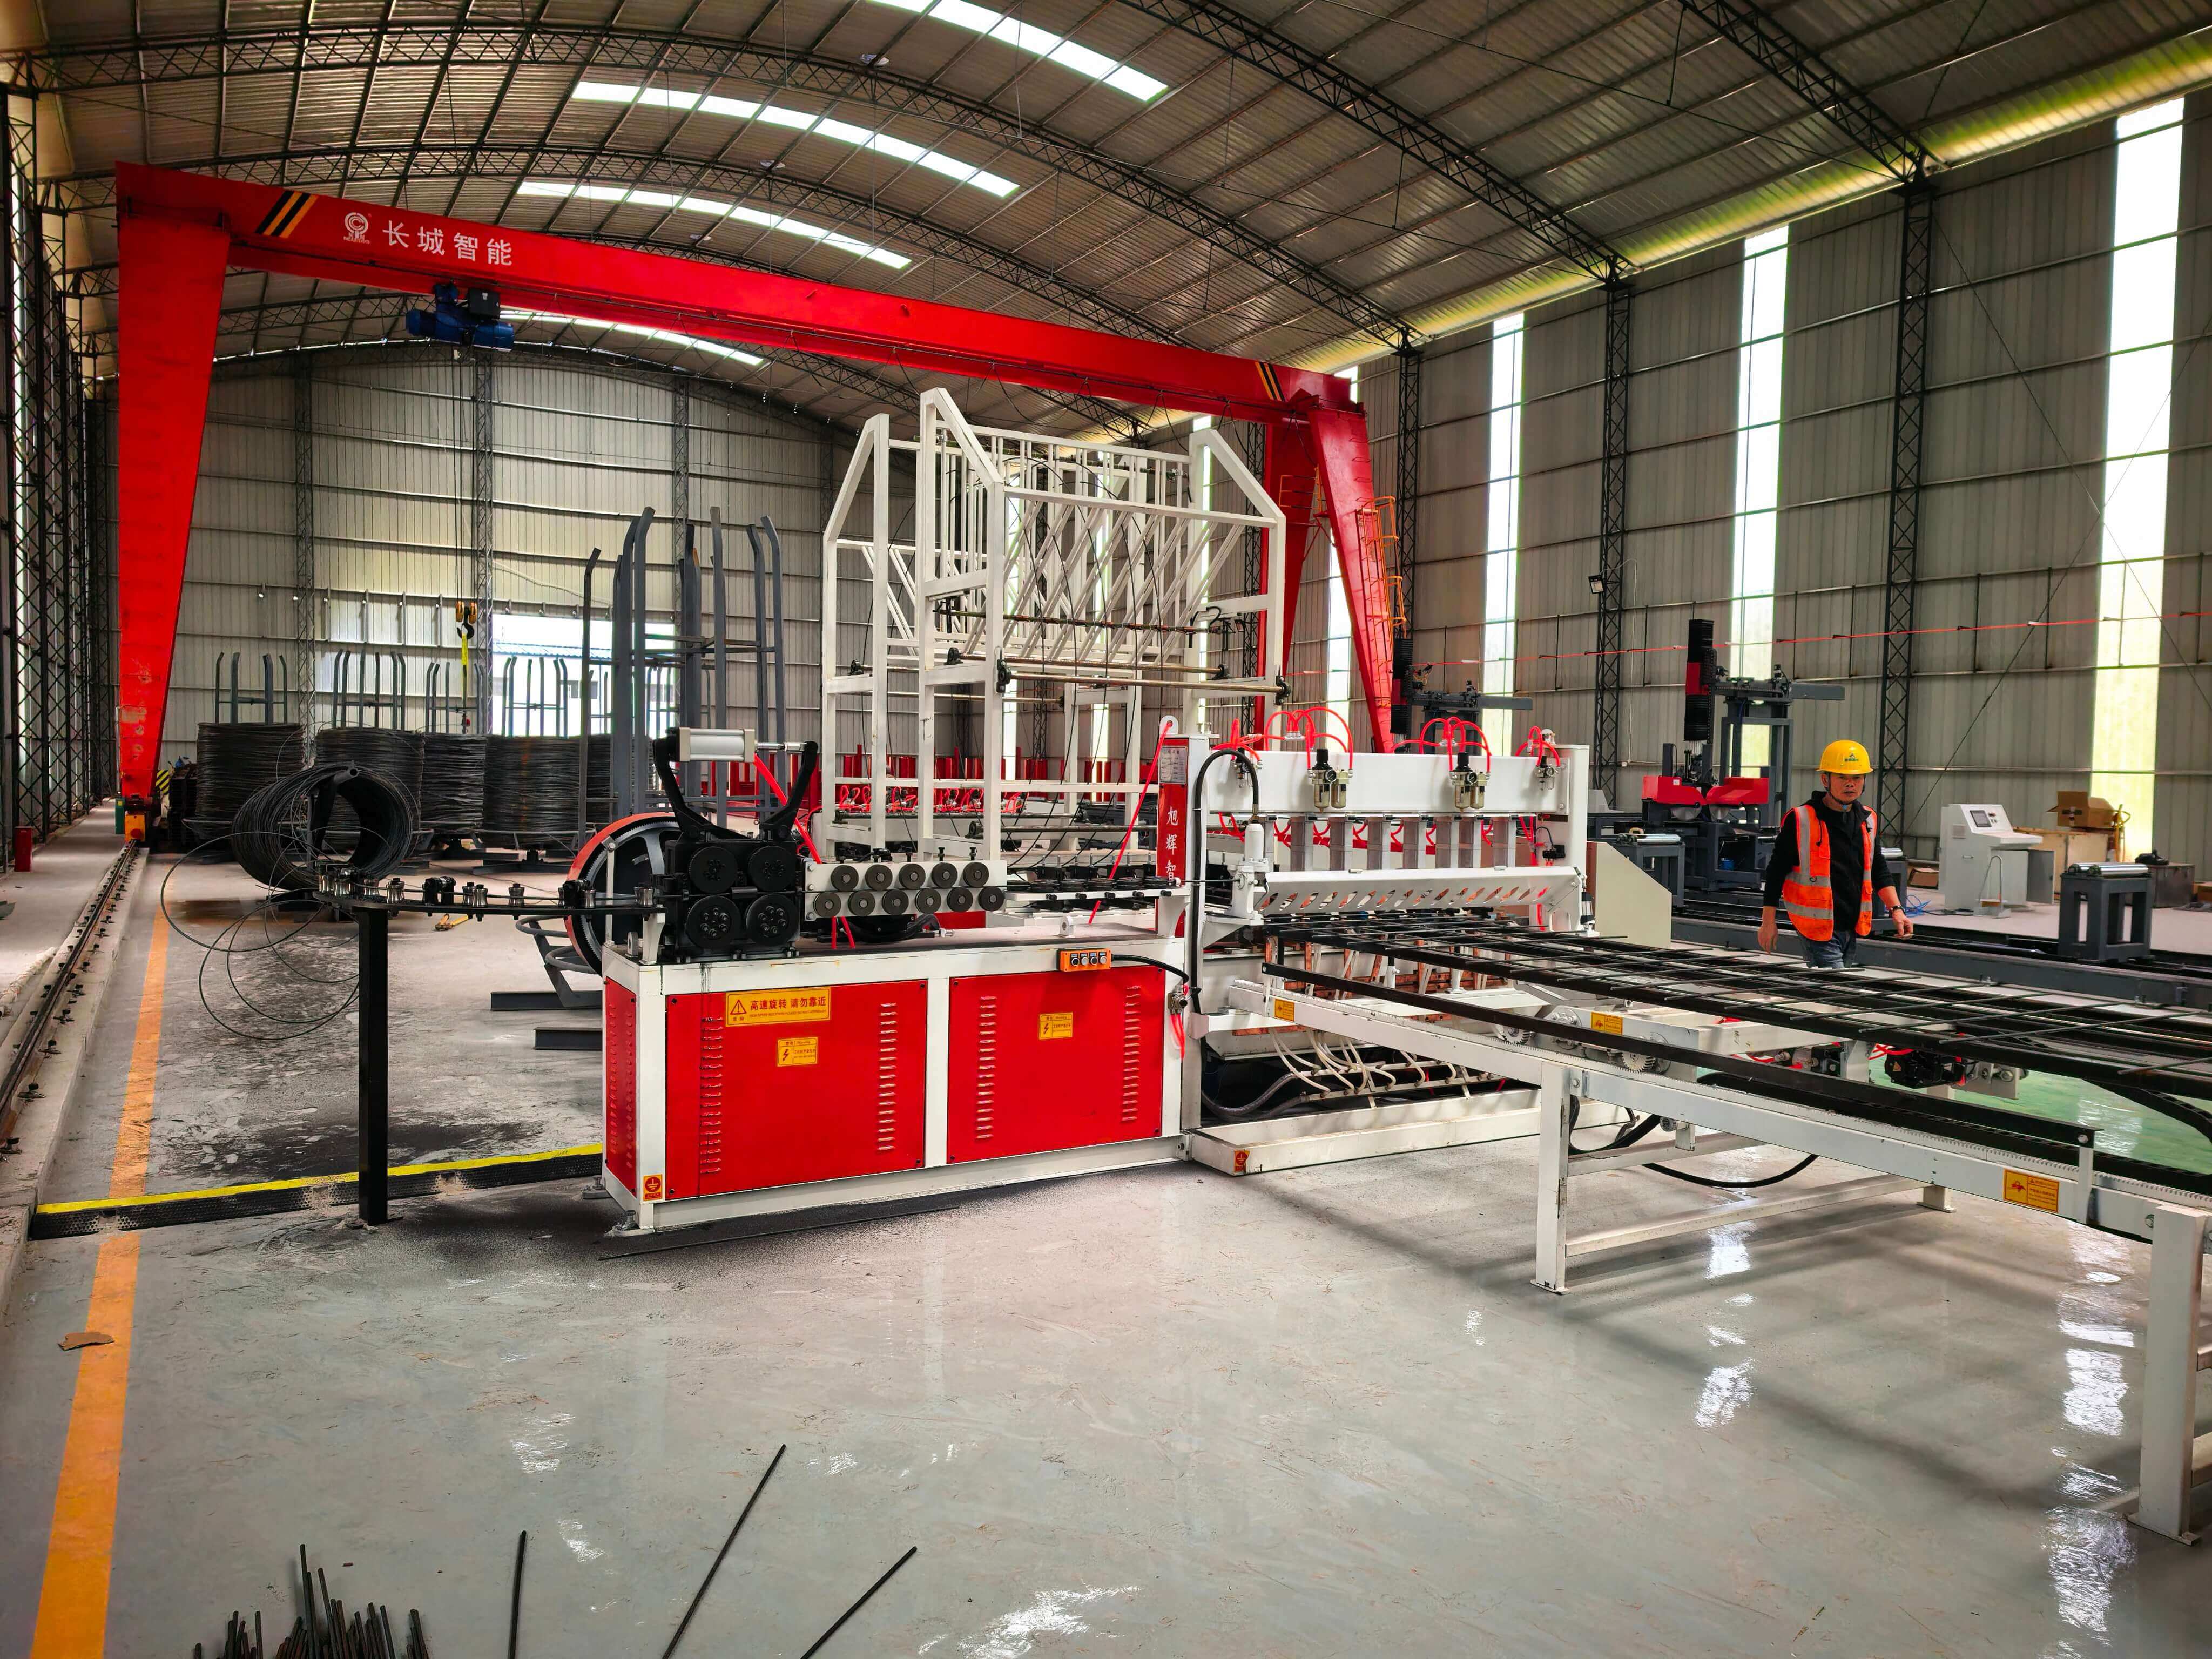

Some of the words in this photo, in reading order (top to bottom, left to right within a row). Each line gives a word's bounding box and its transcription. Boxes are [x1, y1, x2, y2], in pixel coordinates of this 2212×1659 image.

[382, 220, 512, 266] 长城智能
[750, 999, 787, 1011] 高速旋转
[791, 996, 826, 1008] 请勿靠近
